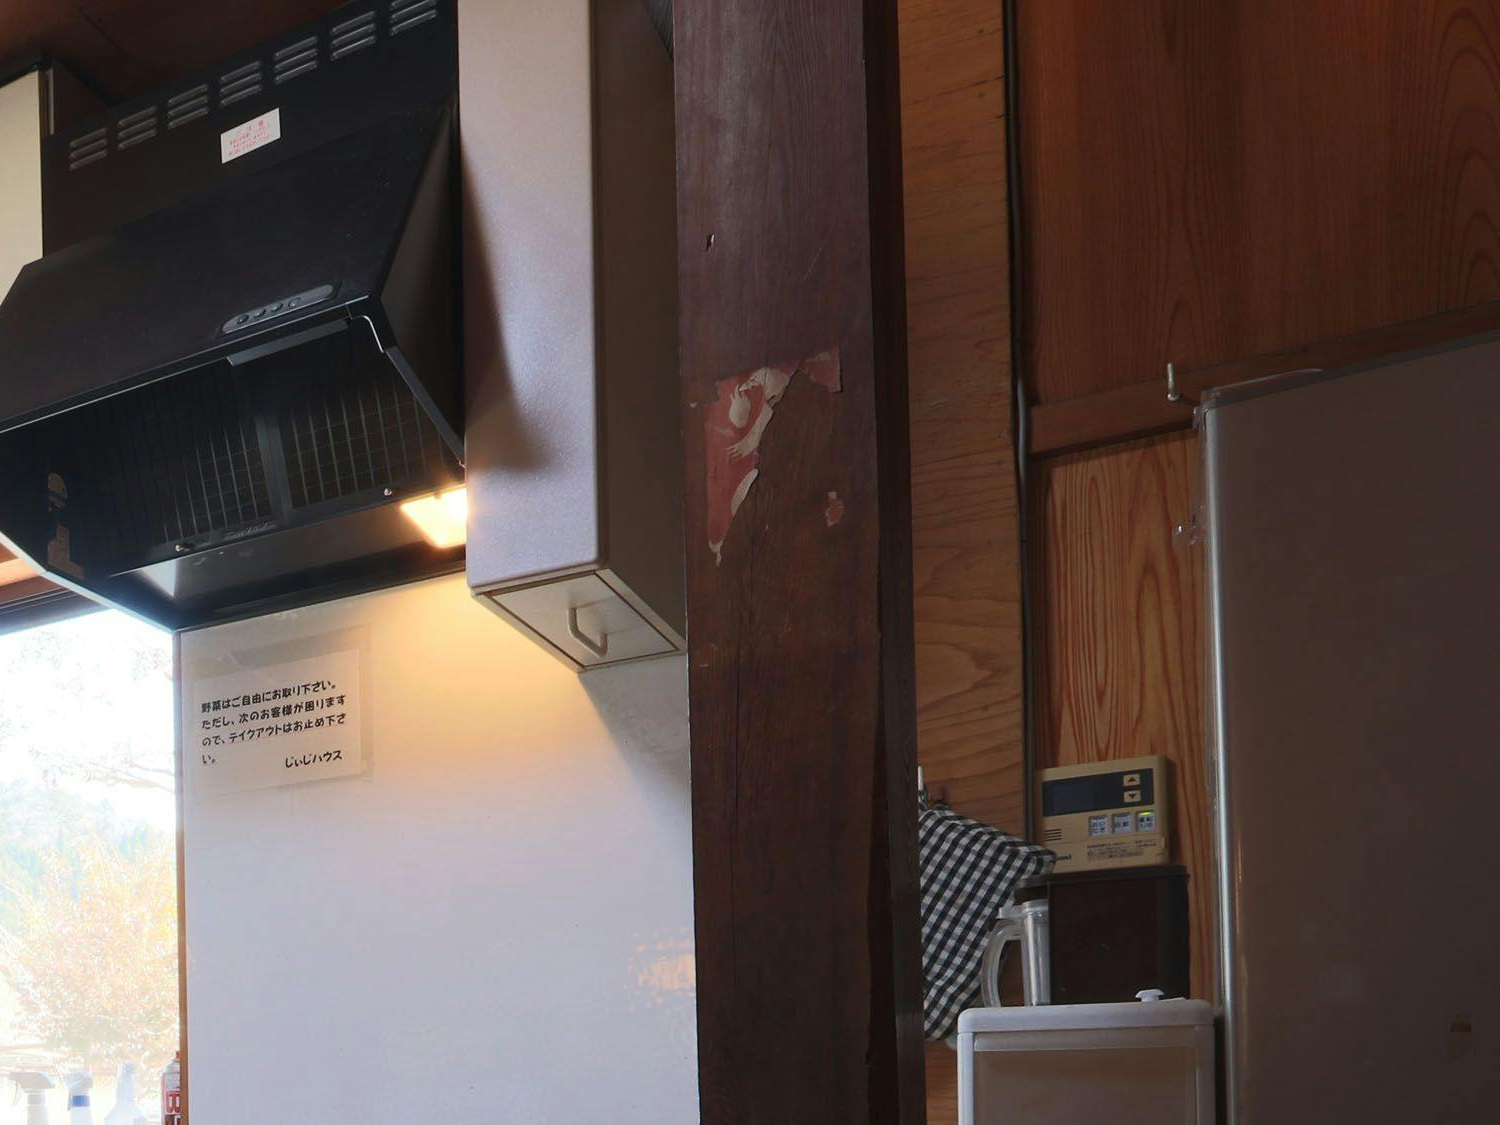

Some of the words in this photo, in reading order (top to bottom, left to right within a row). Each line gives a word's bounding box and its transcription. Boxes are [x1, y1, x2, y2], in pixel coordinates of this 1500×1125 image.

[201, 680, 336, 714] 野菜はご自由にお取り下さい。
[202, 694, 347, 730] ただし、次のお客様が困ります
[202, 713, 347, 747] ので、テイクアウトはお止め下さ
